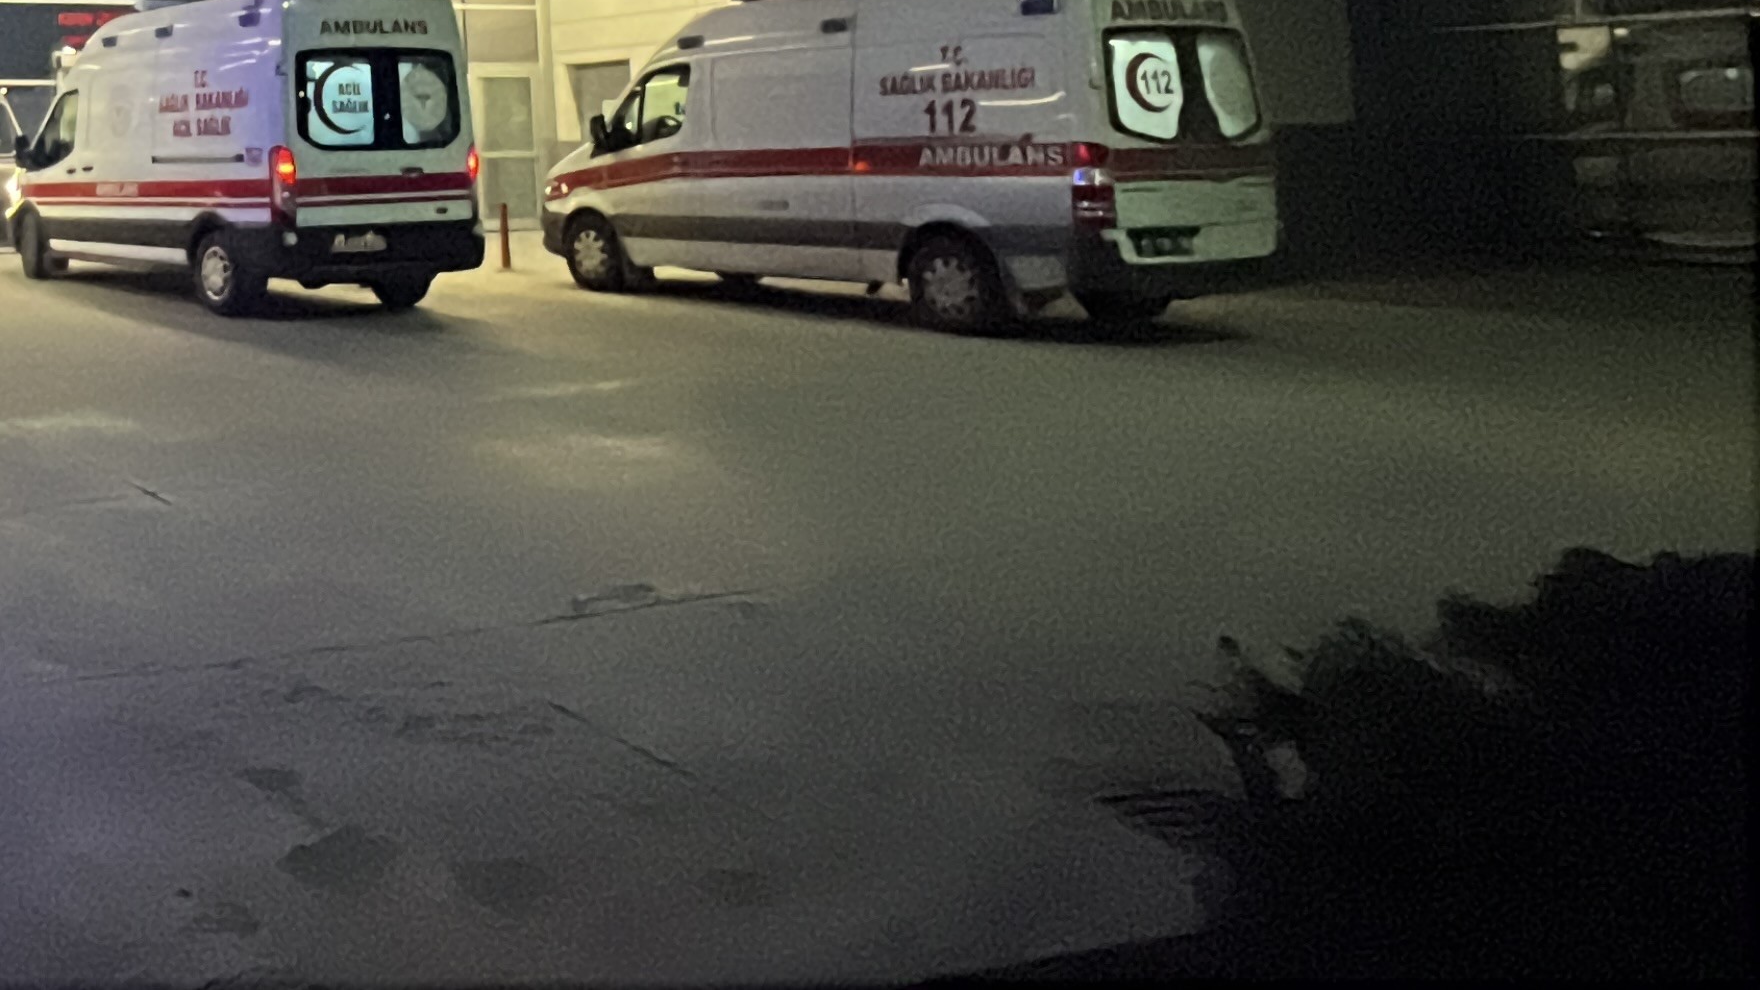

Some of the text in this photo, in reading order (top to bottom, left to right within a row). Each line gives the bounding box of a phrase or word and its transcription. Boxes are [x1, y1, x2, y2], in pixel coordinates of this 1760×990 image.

[320, 18, 428, 35] AMBULANS
[1140, 69, 1174, 95] 112
[924, 98, 977, 133] 112
[919, 145, 1064, 166] AMBULANS
